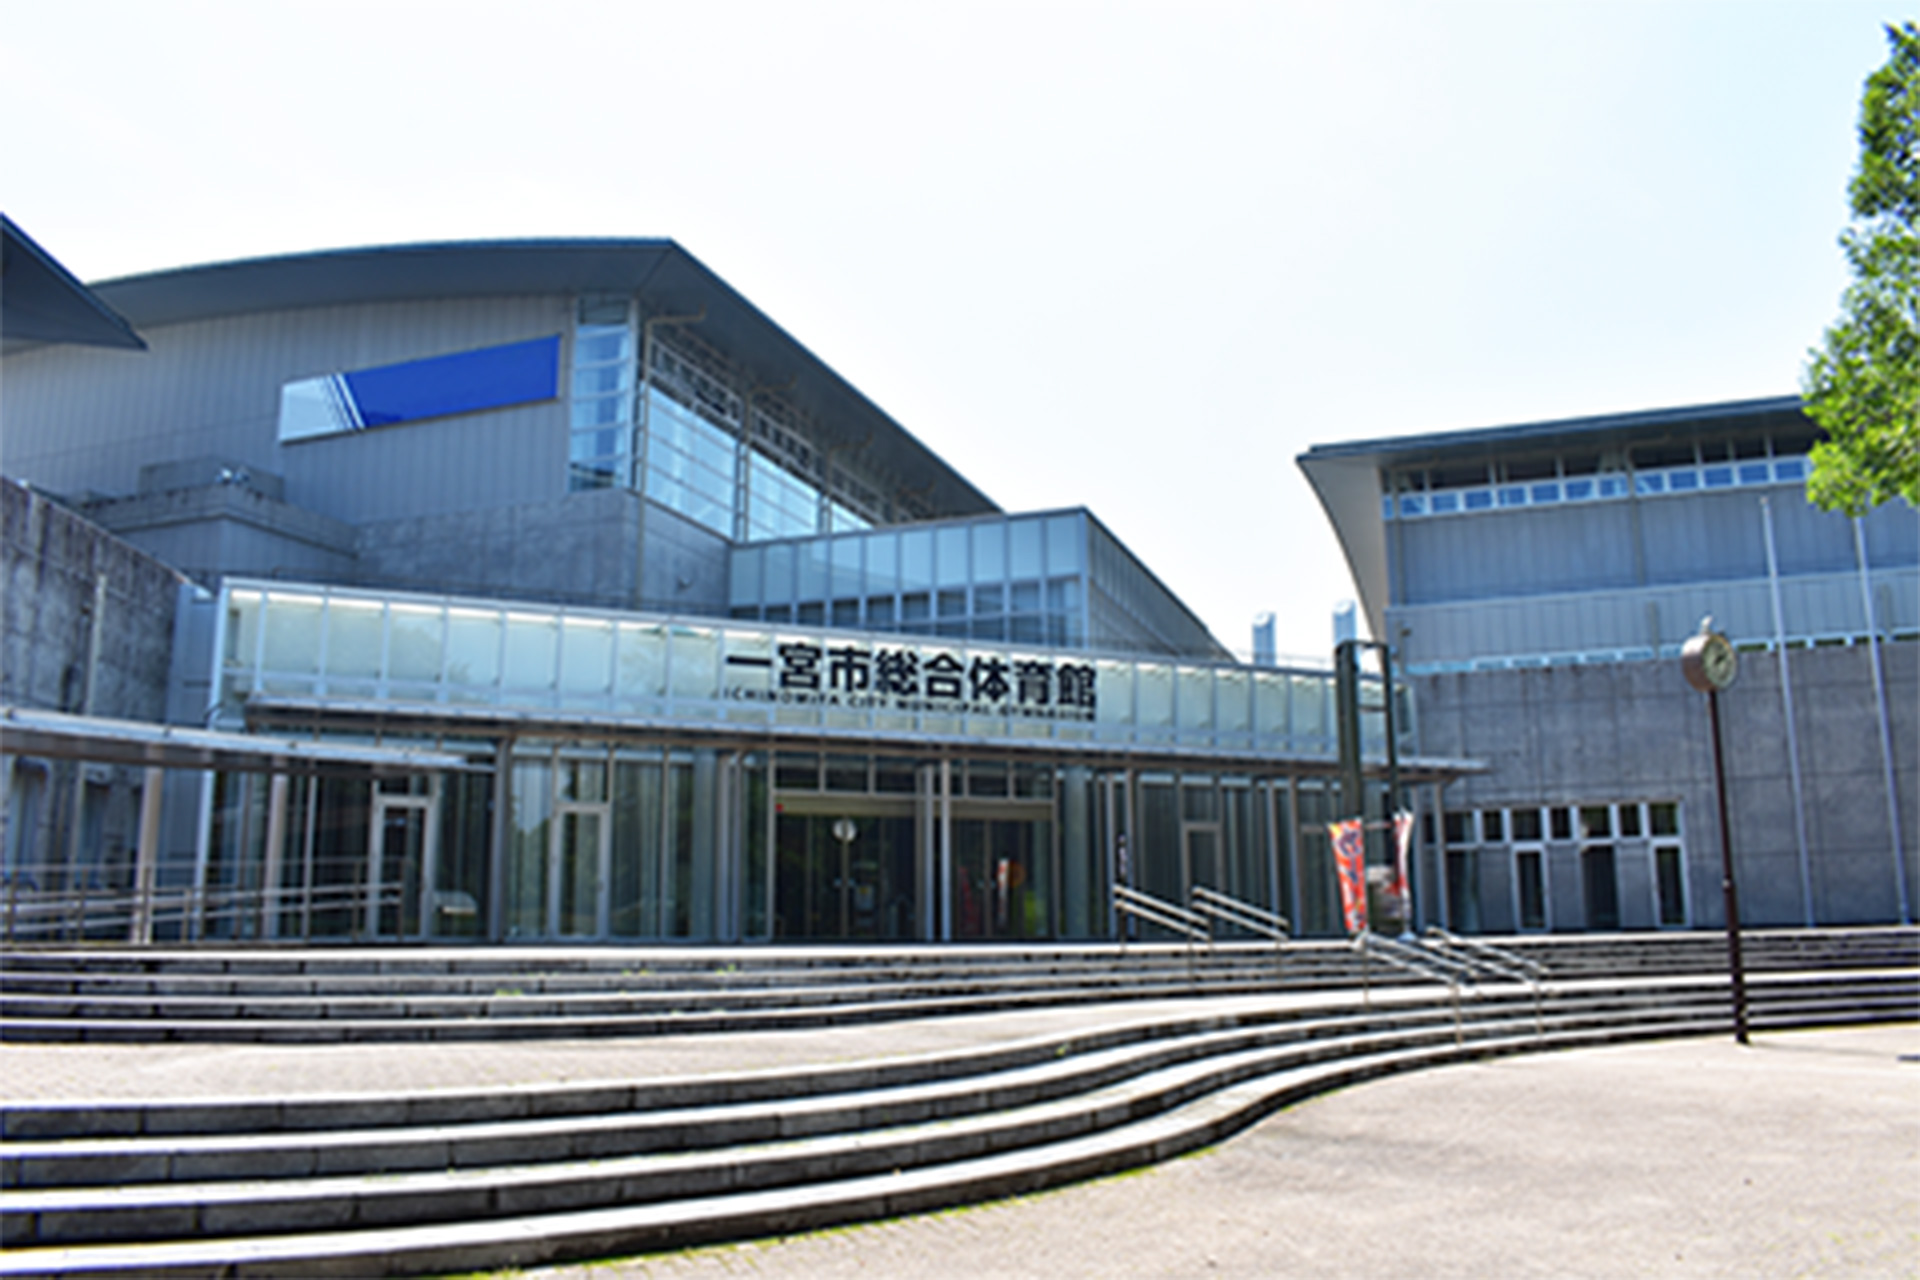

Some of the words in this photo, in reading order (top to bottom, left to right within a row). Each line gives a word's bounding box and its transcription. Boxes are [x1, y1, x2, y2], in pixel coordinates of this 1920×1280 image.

[725, 643, 1097, 708] 一宮市総合体育館
[847, 694, 888, 709] CITY
